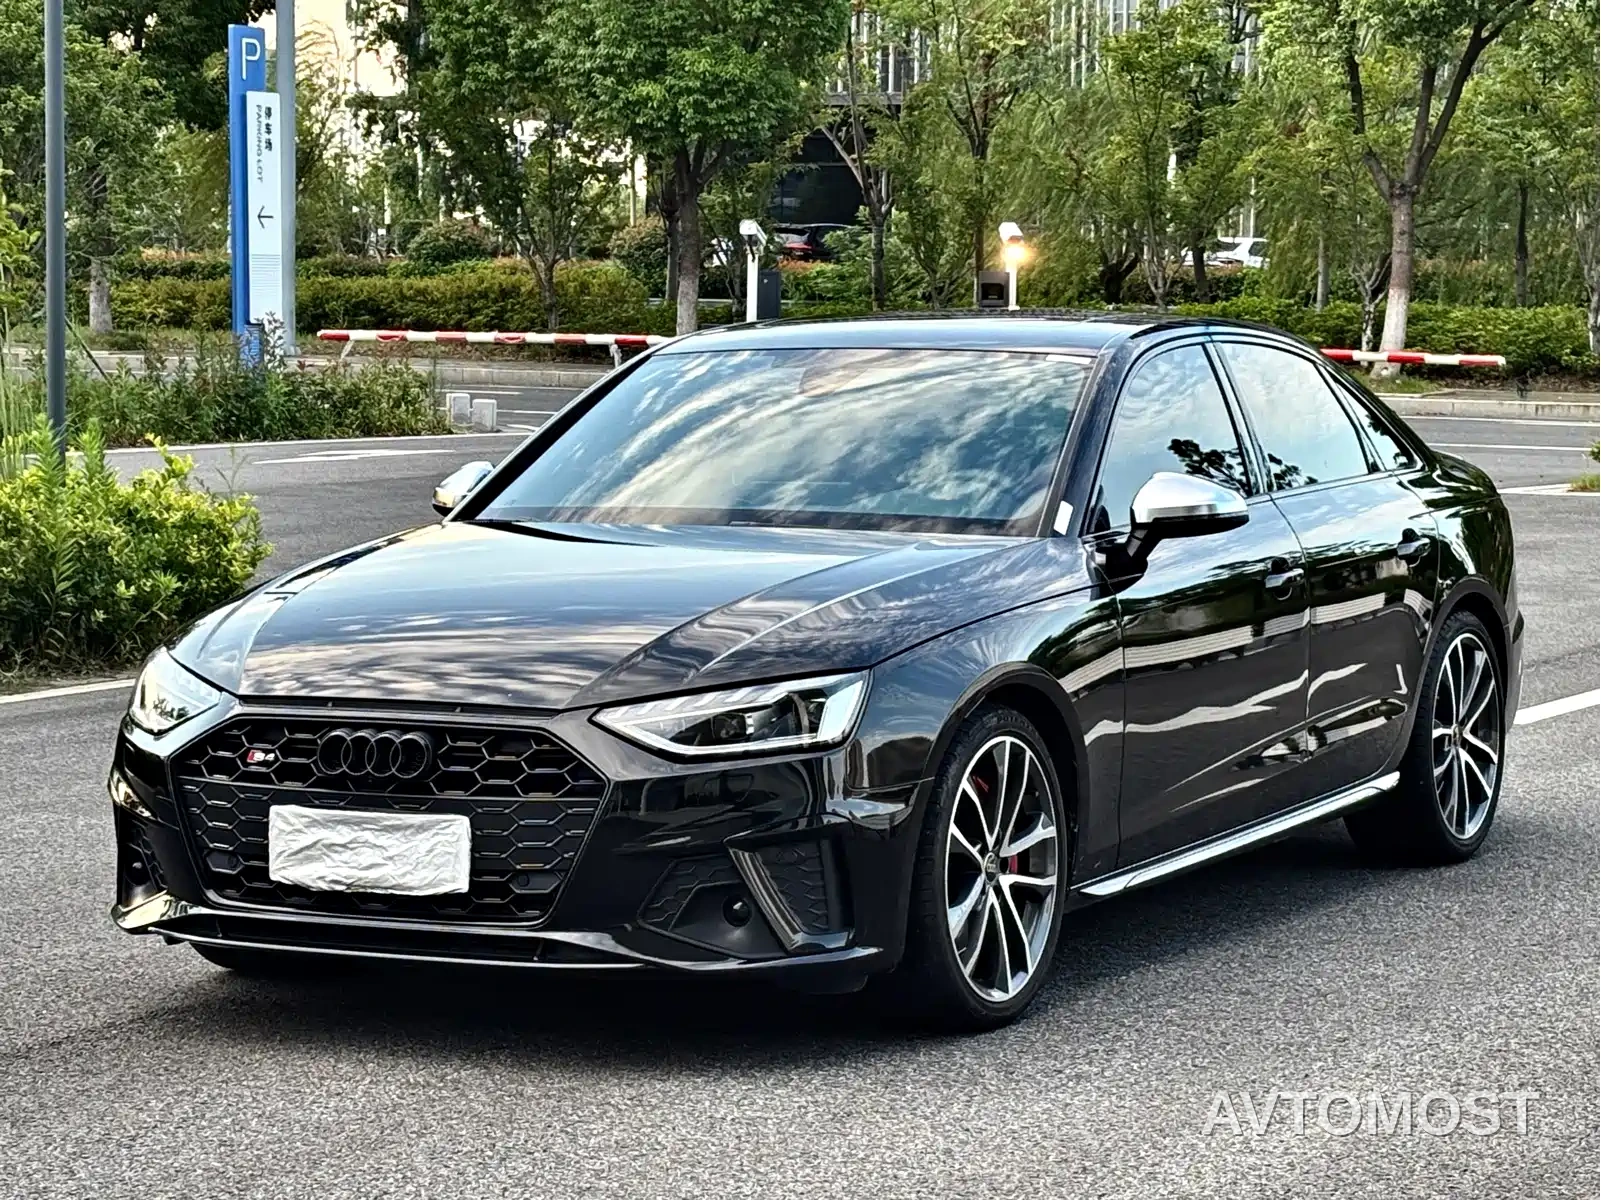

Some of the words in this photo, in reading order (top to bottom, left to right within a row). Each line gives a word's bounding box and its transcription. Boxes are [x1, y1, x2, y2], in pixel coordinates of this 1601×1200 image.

[241, 37, 260, 80] P
[256, 104, 264, 157] PARKING
[264, 106, 273, 152] 停车场
[256, 159, 264, 183] LOT
[252, 751, 276, 762] S4
